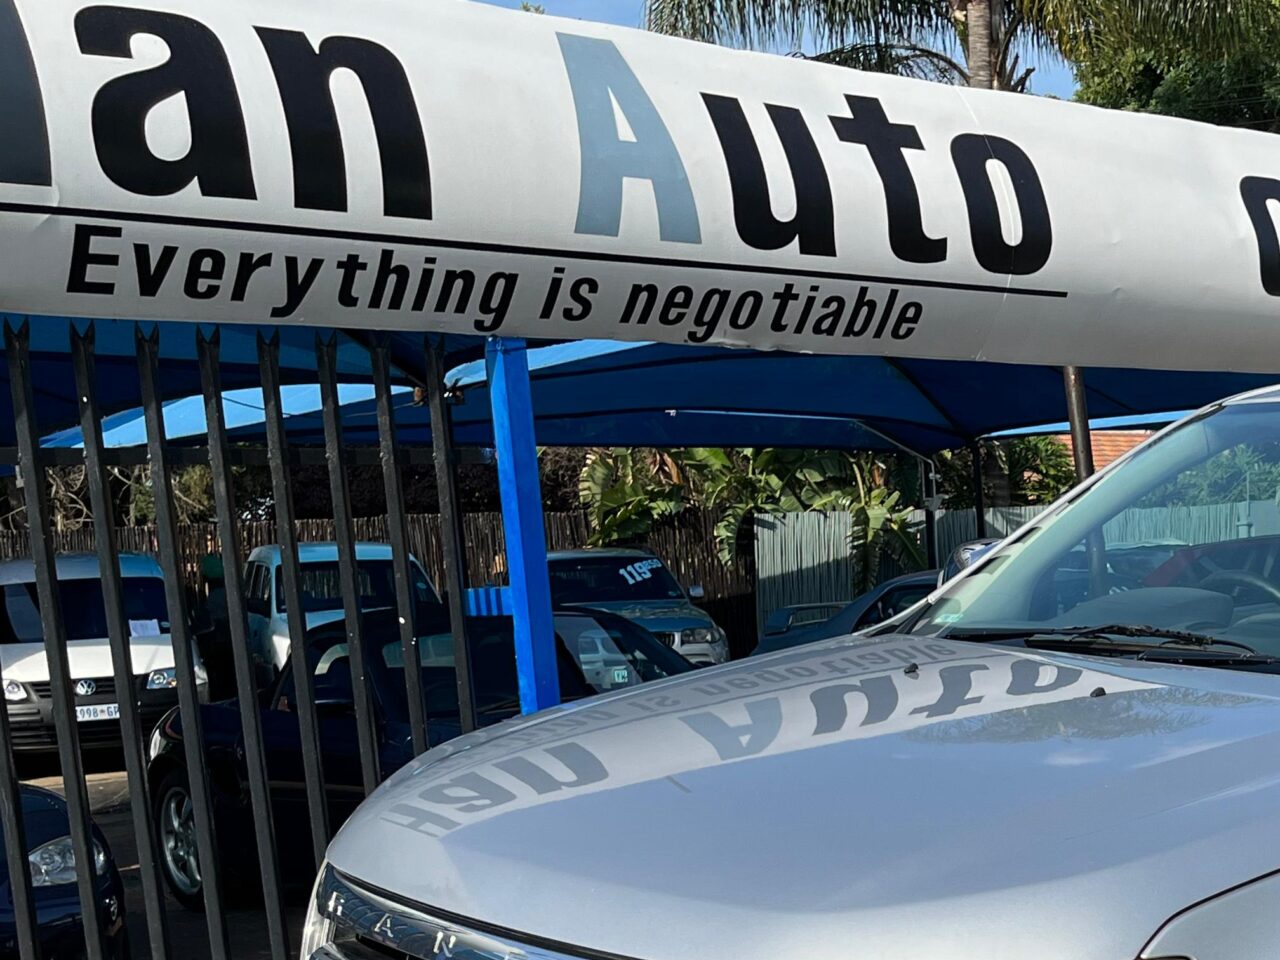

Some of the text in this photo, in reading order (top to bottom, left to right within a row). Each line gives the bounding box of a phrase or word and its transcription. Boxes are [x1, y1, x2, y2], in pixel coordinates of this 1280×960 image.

[555, 32, 1052, 275] Auto
[66, 223, 923, 343] Everything is negotiable
[76, 706, 99, 719] 998
